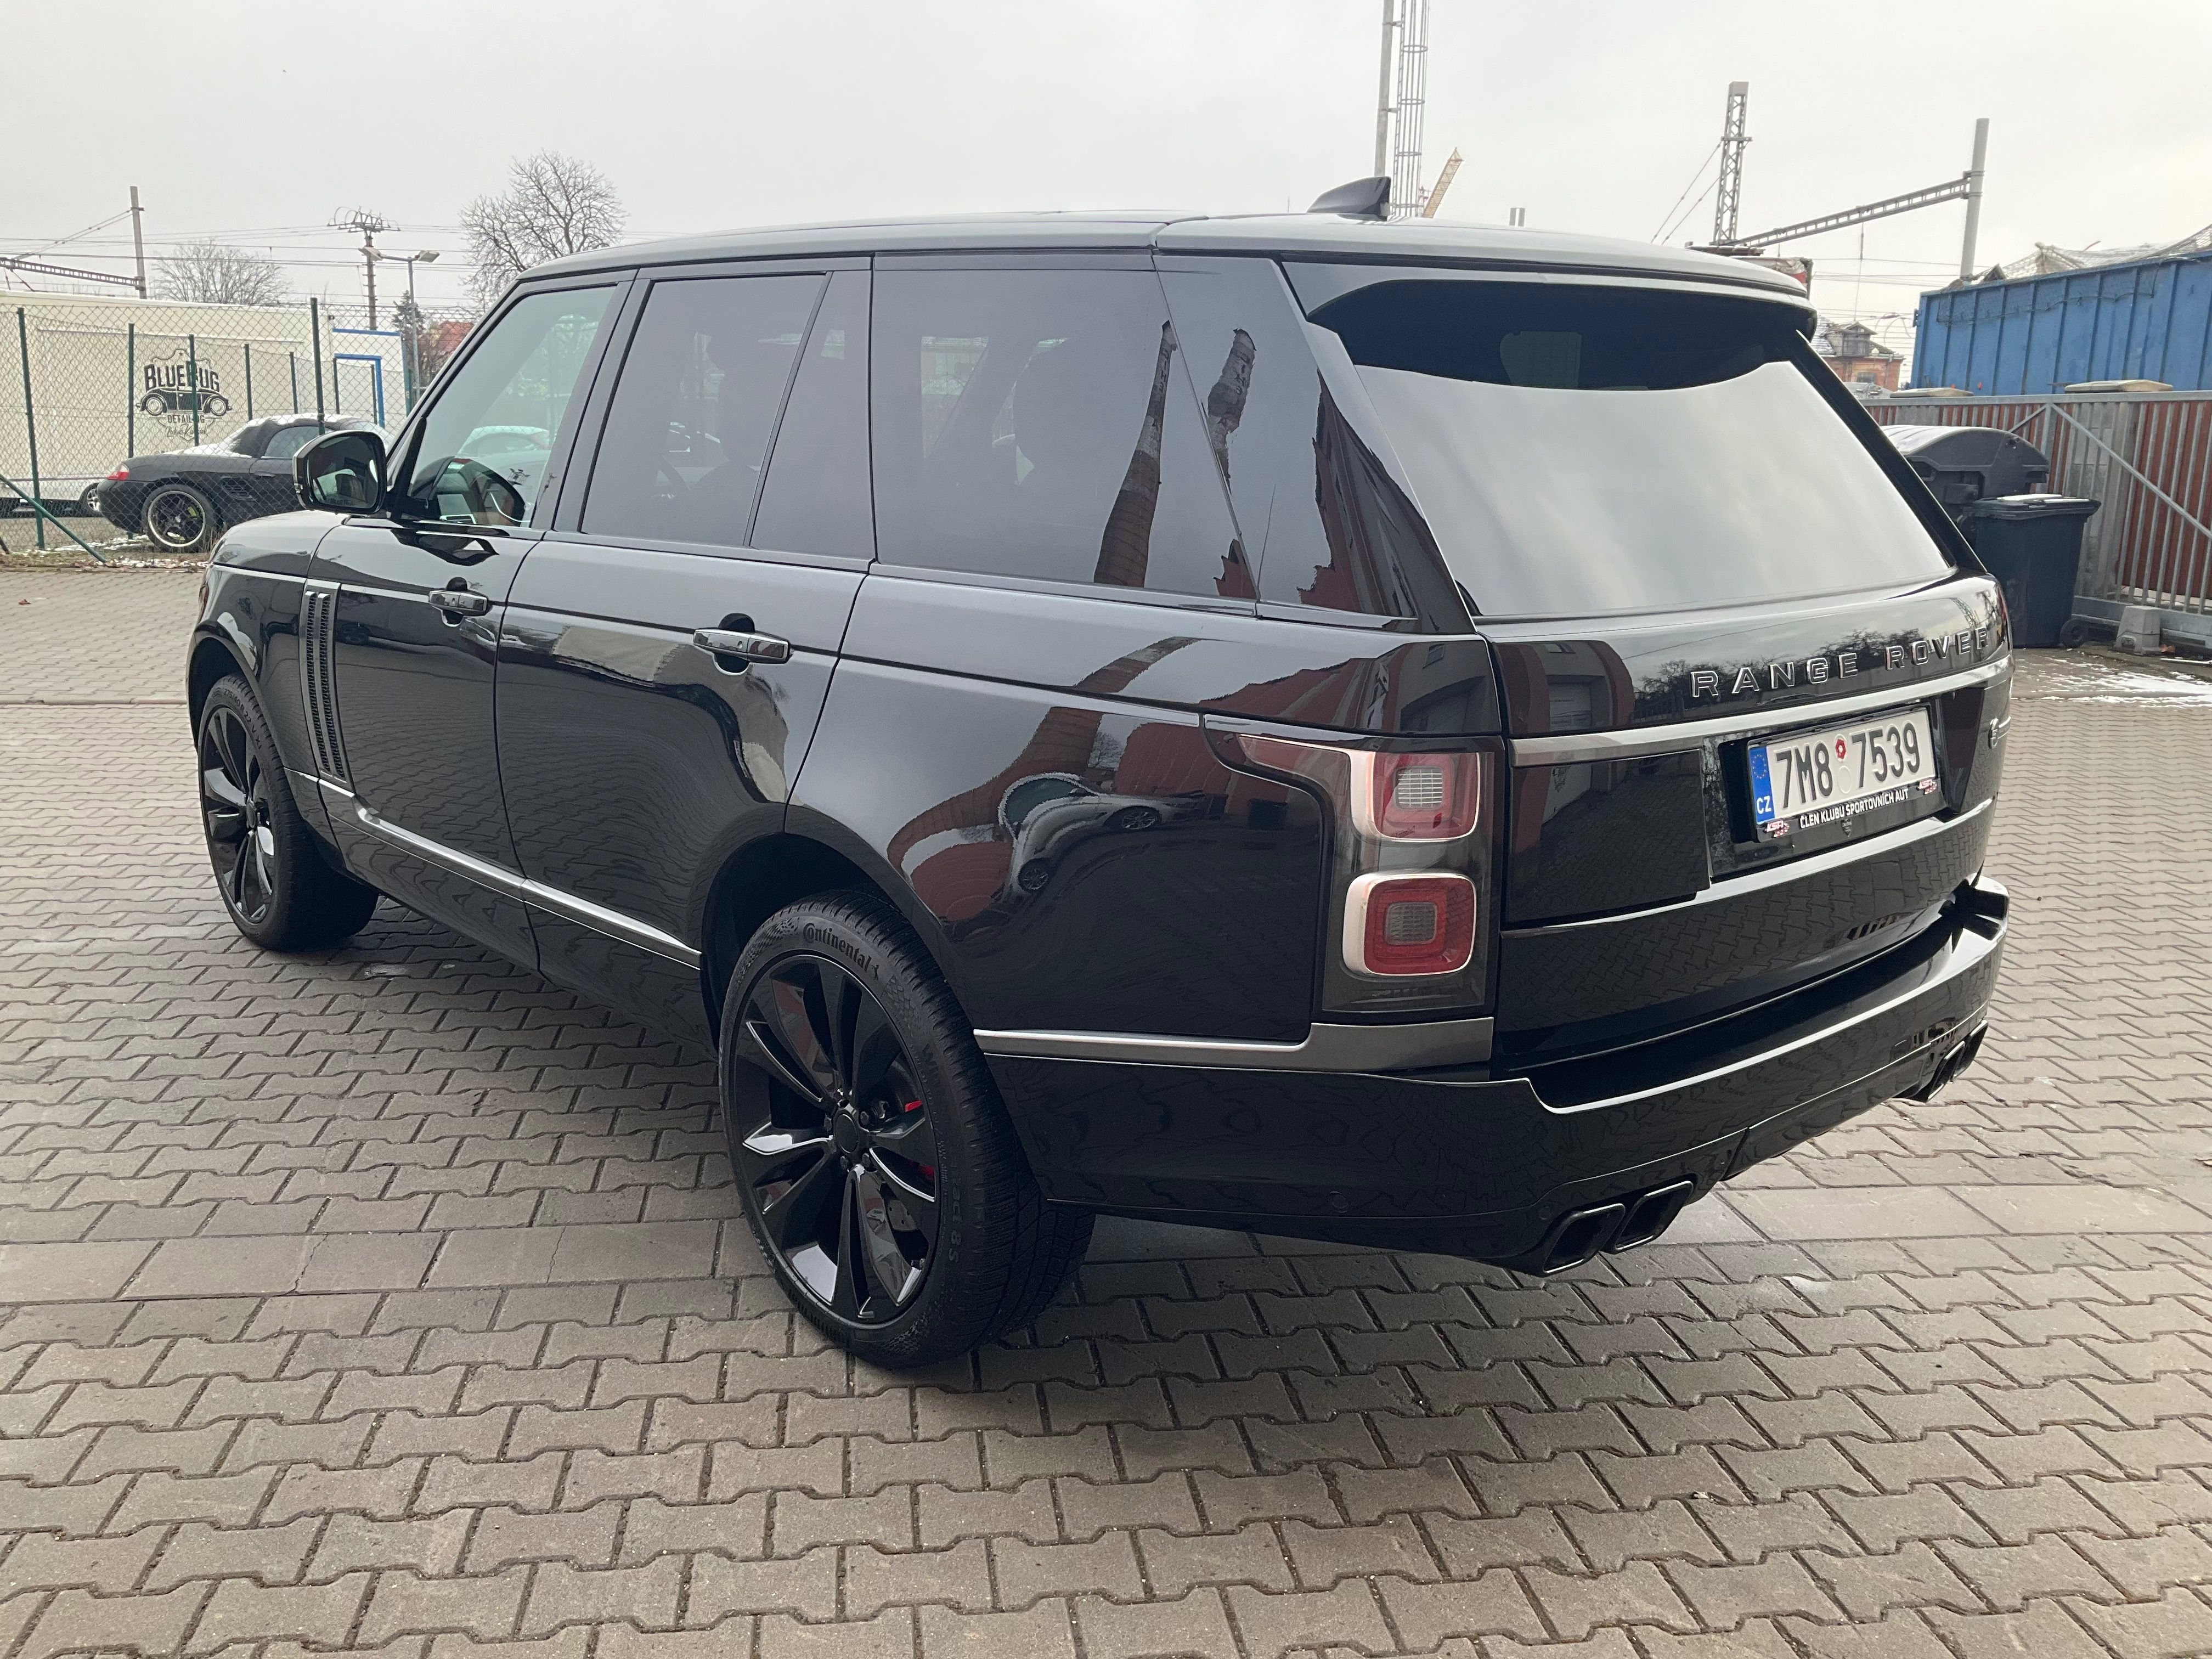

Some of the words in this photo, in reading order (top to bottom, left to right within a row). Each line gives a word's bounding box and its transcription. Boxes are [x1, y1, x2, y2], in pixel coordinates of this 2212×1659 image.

[167, 415, 205, 424] DETAILG
[1690, 652, 1858, 698] RANGE
[1885, 627, 1990, 670] ROVER
[1776, 742, 1833, 809] 7M8
[1851, 722, 1920, 788] 7539
[1756, 795, 1772, 814] CZ
[1820, 805, 1846, 823] KLUBU
[1845, 792, 1894, 816] SPORTOVNÍCH
[1894, 788, 1909, 802] AUT
[803, 922, 872, 973] Continental
